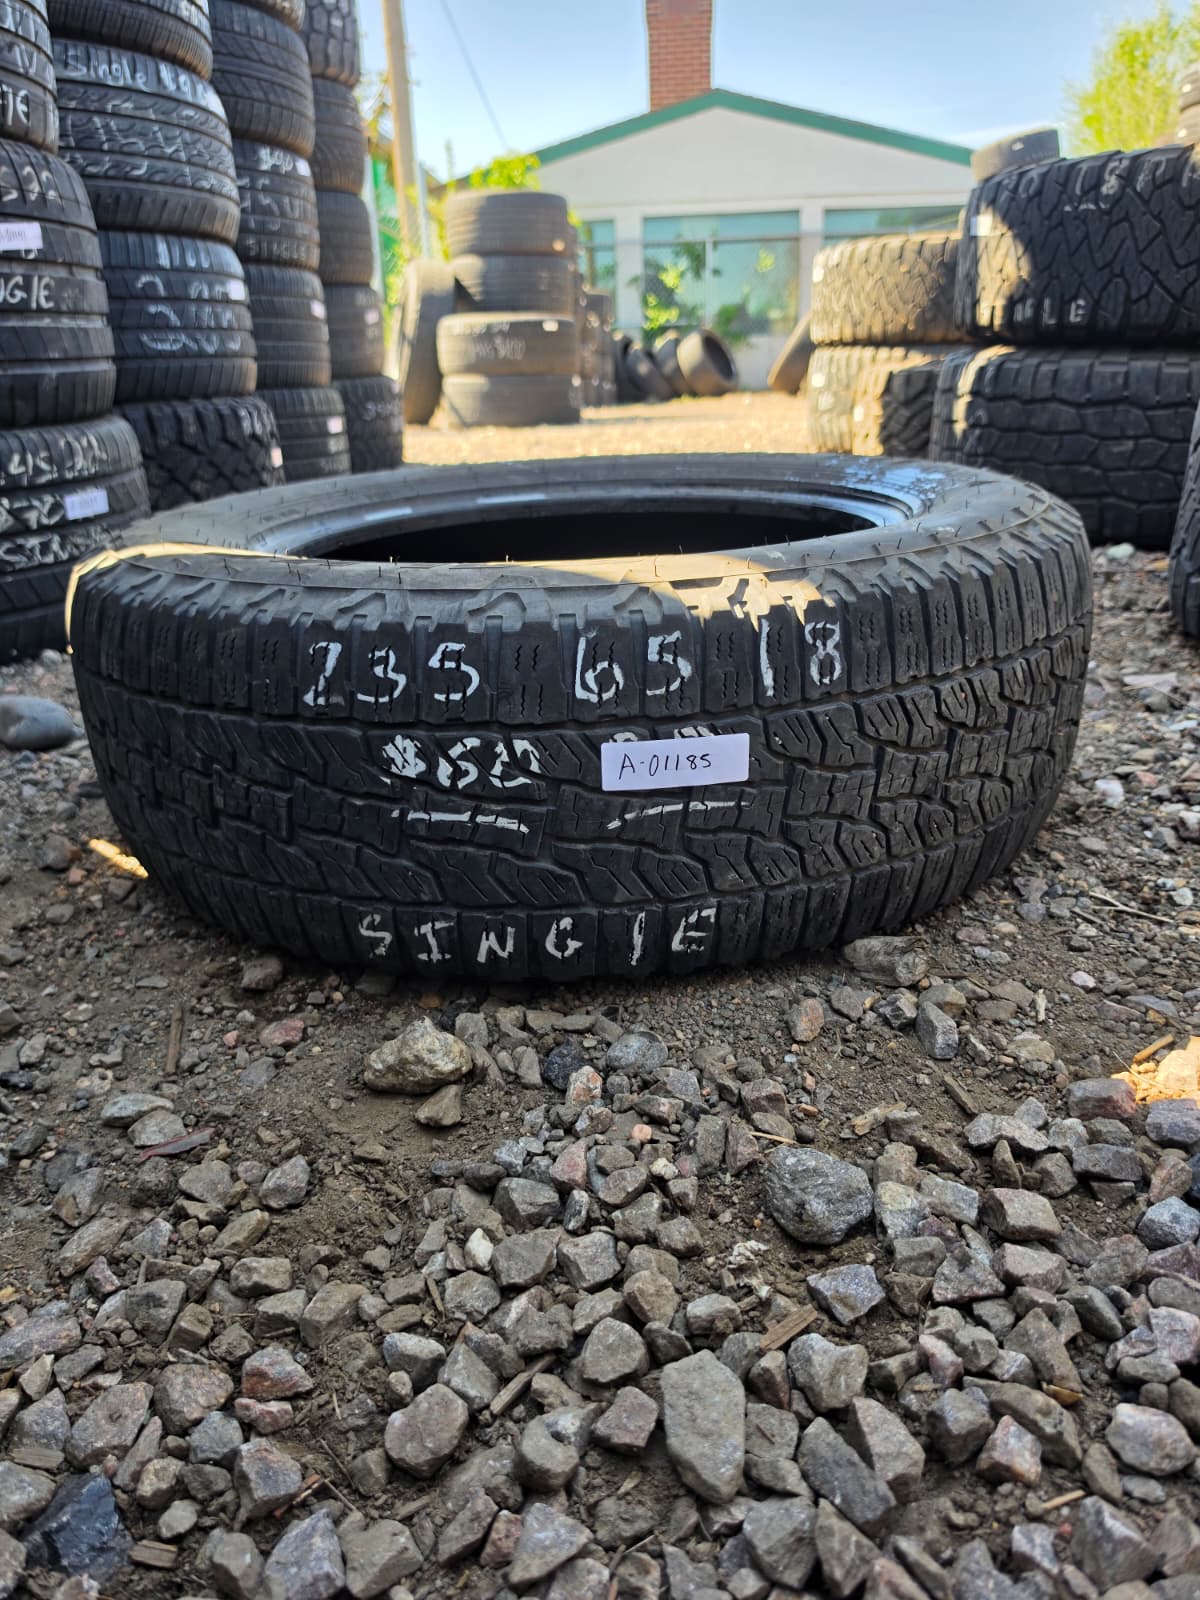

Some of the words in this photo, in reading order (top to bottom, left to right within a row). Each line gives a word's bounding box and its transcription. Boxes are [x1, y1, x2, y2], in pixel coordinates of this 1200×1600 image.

[303, 640, 481, 708] 235
[574, 630, 693, 704] 65
[759, 618, 843, 698] 18
[617, 752, 713, 781] A-01185
